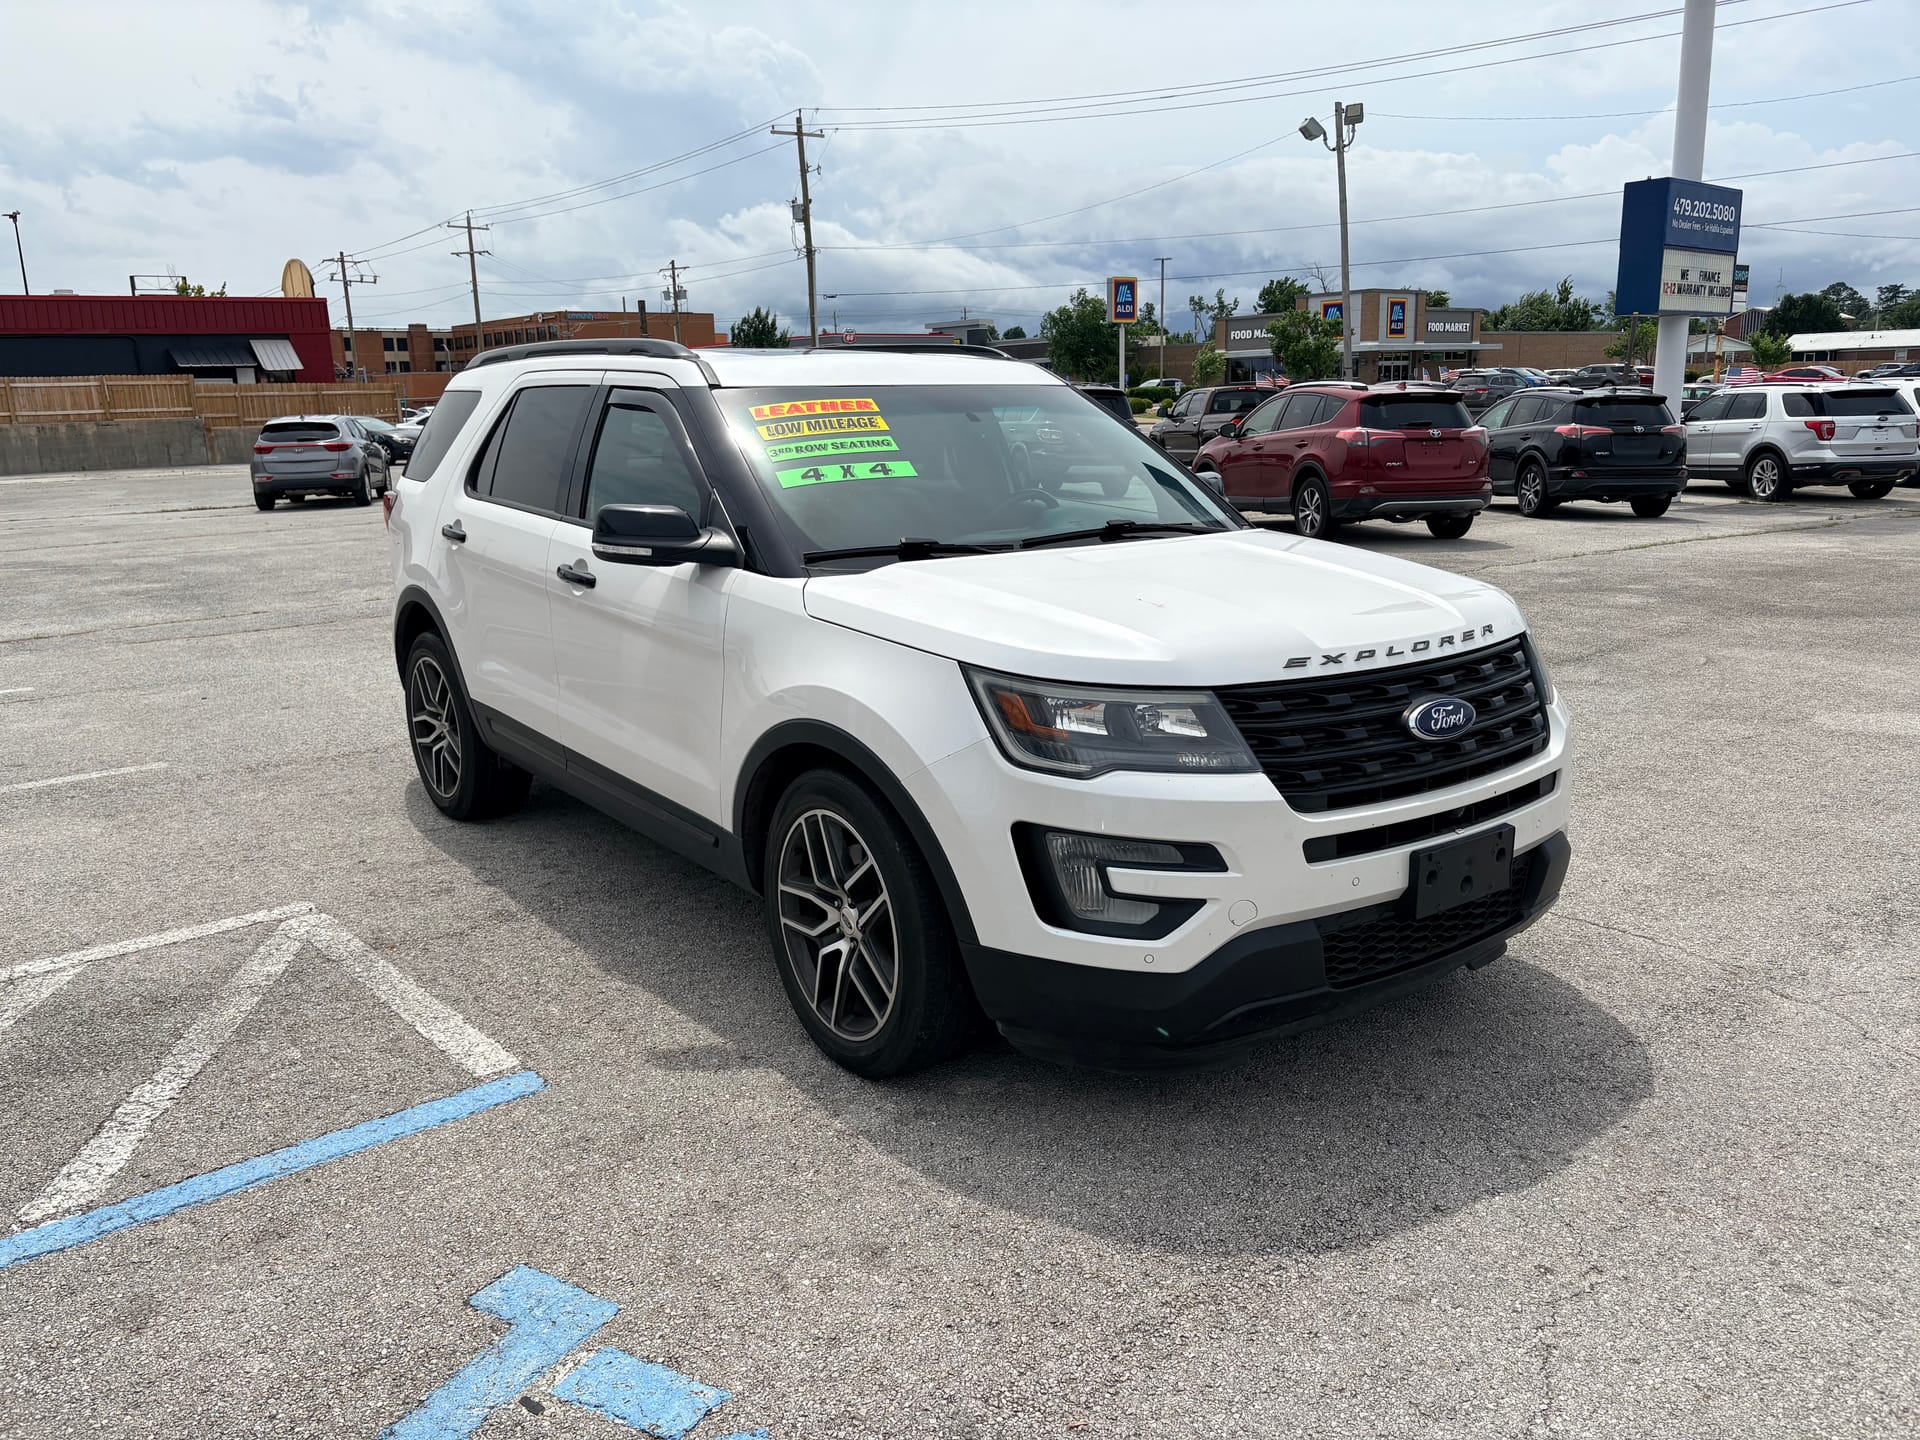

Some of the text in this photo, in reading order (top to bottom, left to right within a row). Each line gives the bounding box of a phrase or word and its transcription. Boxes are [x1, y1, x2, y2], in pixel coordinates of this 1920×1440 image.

[1673, 197, 1736, 222] 479.202.5080
[1680, 269, 1721, 283] WE FINANCE
[1663, 282, 1677, 295] 12-12
[1677, 283, 1706, 297] WARRANTY
[1707, 285, 1731, 298] INCLUDED
[1116, 304, 1133, 313] ALDI
[1230, 330, 1252, 340] FOOD
[1391, 322, 1404, 330] ALDI
[1427, 322, 1470, 332] FOOD MARKET
[754, 400, 874, 419] LEATHER
[766, 416, 880, 437] LOW MILEAGE
[769, 438, 892, 458] 3RD ROW SEATING
[801, 462, 893, 481] 4 X 4
[1282, 623, 1495, 669] EXPLORER
[1431, 704, 1466, 731] Ford
